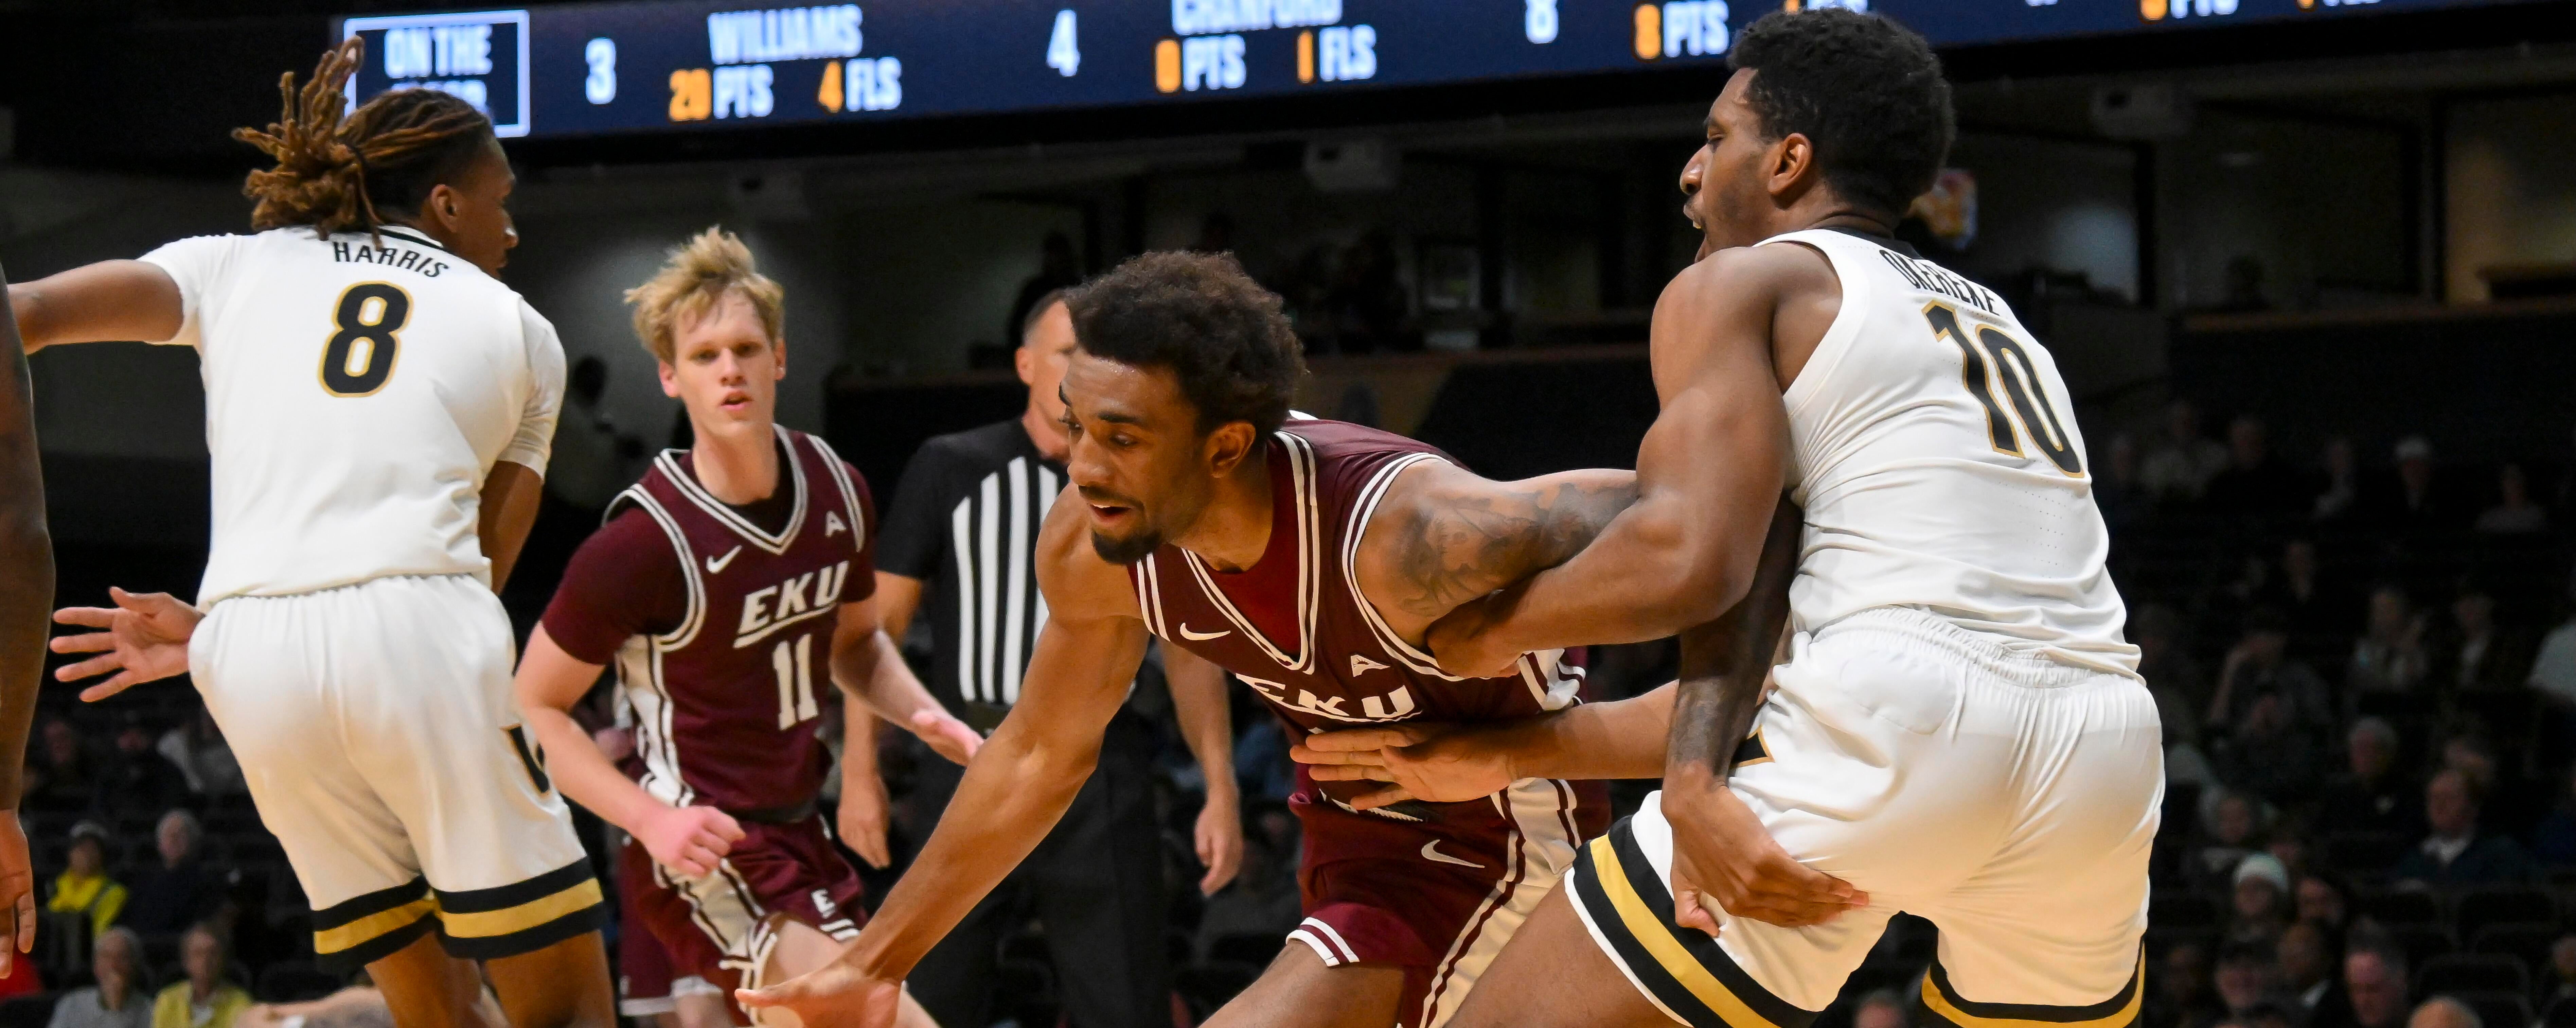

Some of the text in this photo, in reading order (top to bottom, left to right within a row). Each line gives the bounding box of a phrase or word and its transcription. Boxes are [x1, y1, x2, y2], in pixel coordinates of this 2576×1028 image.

[385, 24, 492, 78] ON THE
[708, 4, 863, 64] WILLIAMS
[1047, 10, 1080, 76] 4
[1183, 35, 1246, 91] PTS
[1298, 31, 1313, 83] 1
[1319, 25, 1376, 81] FLS
[1663, 1, 1728, 57] PTS
[585, 37, 617, 104] 3
[713, 65, 774, 119] PTS
[818, 61, 842, 111] 4
[846, 57, 902, 111] FLS
[332, 242, 449, 277] HARRIS
[317, 280, 414, 398] 8
[1921, 299, 2085, 478] 10
[825, 511, 846, 537] A
[738, 561, 849, 634] EKU
[772, 634, 819, 730] 11
[1236, 673, 1415, 718] EKU
